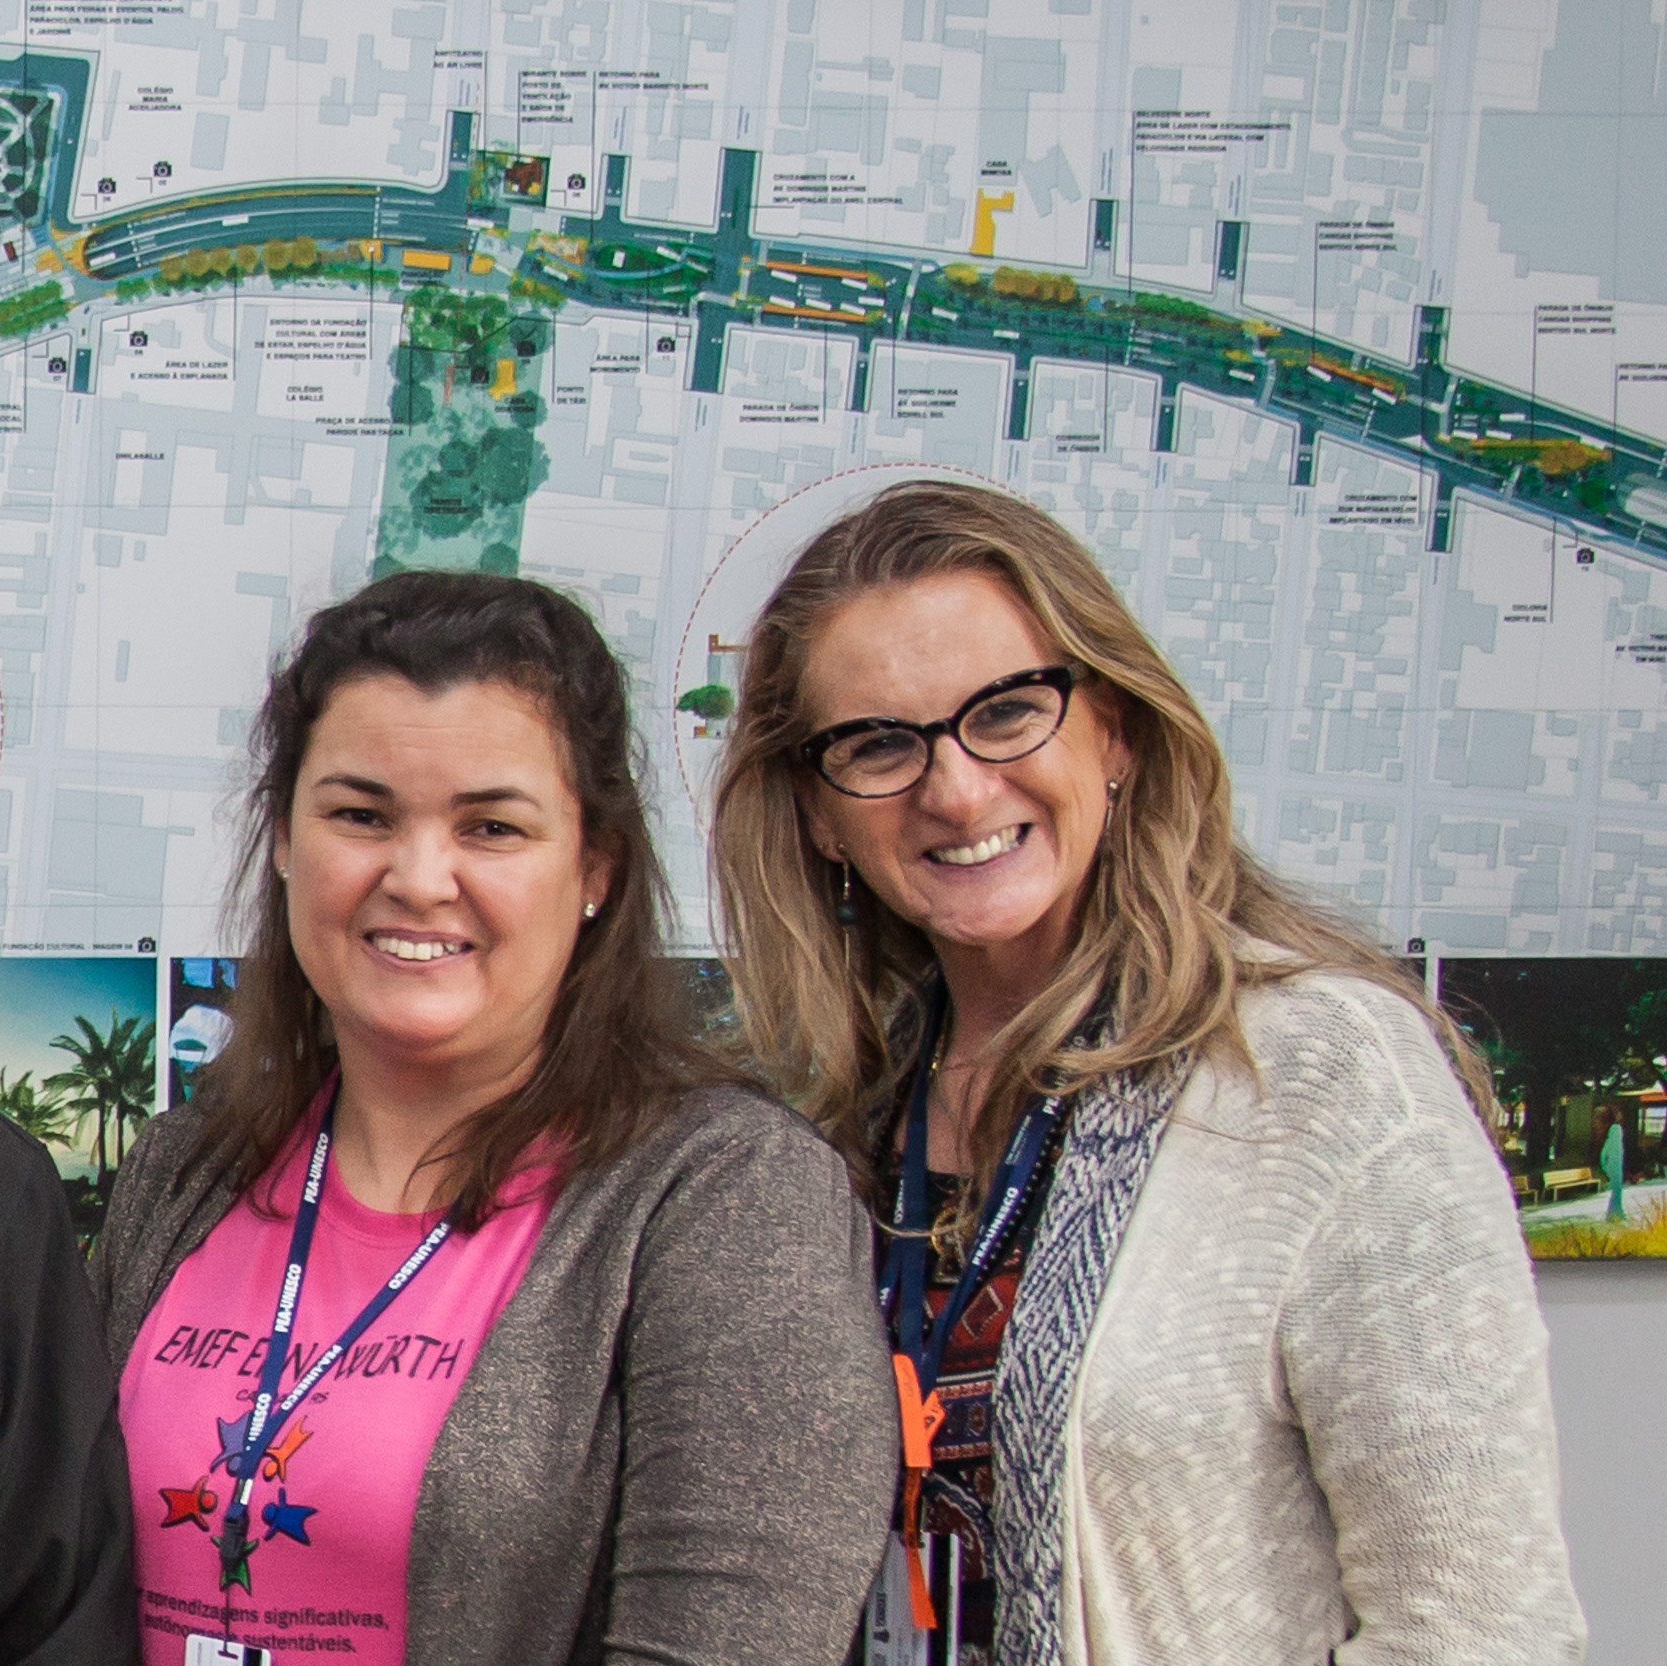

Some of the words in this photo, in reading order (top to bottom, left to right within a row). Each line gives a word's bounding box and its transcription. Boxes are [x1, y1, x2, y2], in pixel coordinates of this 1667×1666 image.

[304, 1133, 330, 1204] PEA-UNESCO
[388, 1221, 450, 1290] PEA-UNESCO
[274, 1263, 302, 1333] PEA-UNESCO
[154, 1325, 248, 1368] EMEF
[280, 1344, 345, 1411] PEA-UNESCO
[146, 1590, 259, 1625] aprendizagens
[264, 1605, 389, 1630] significativas,
